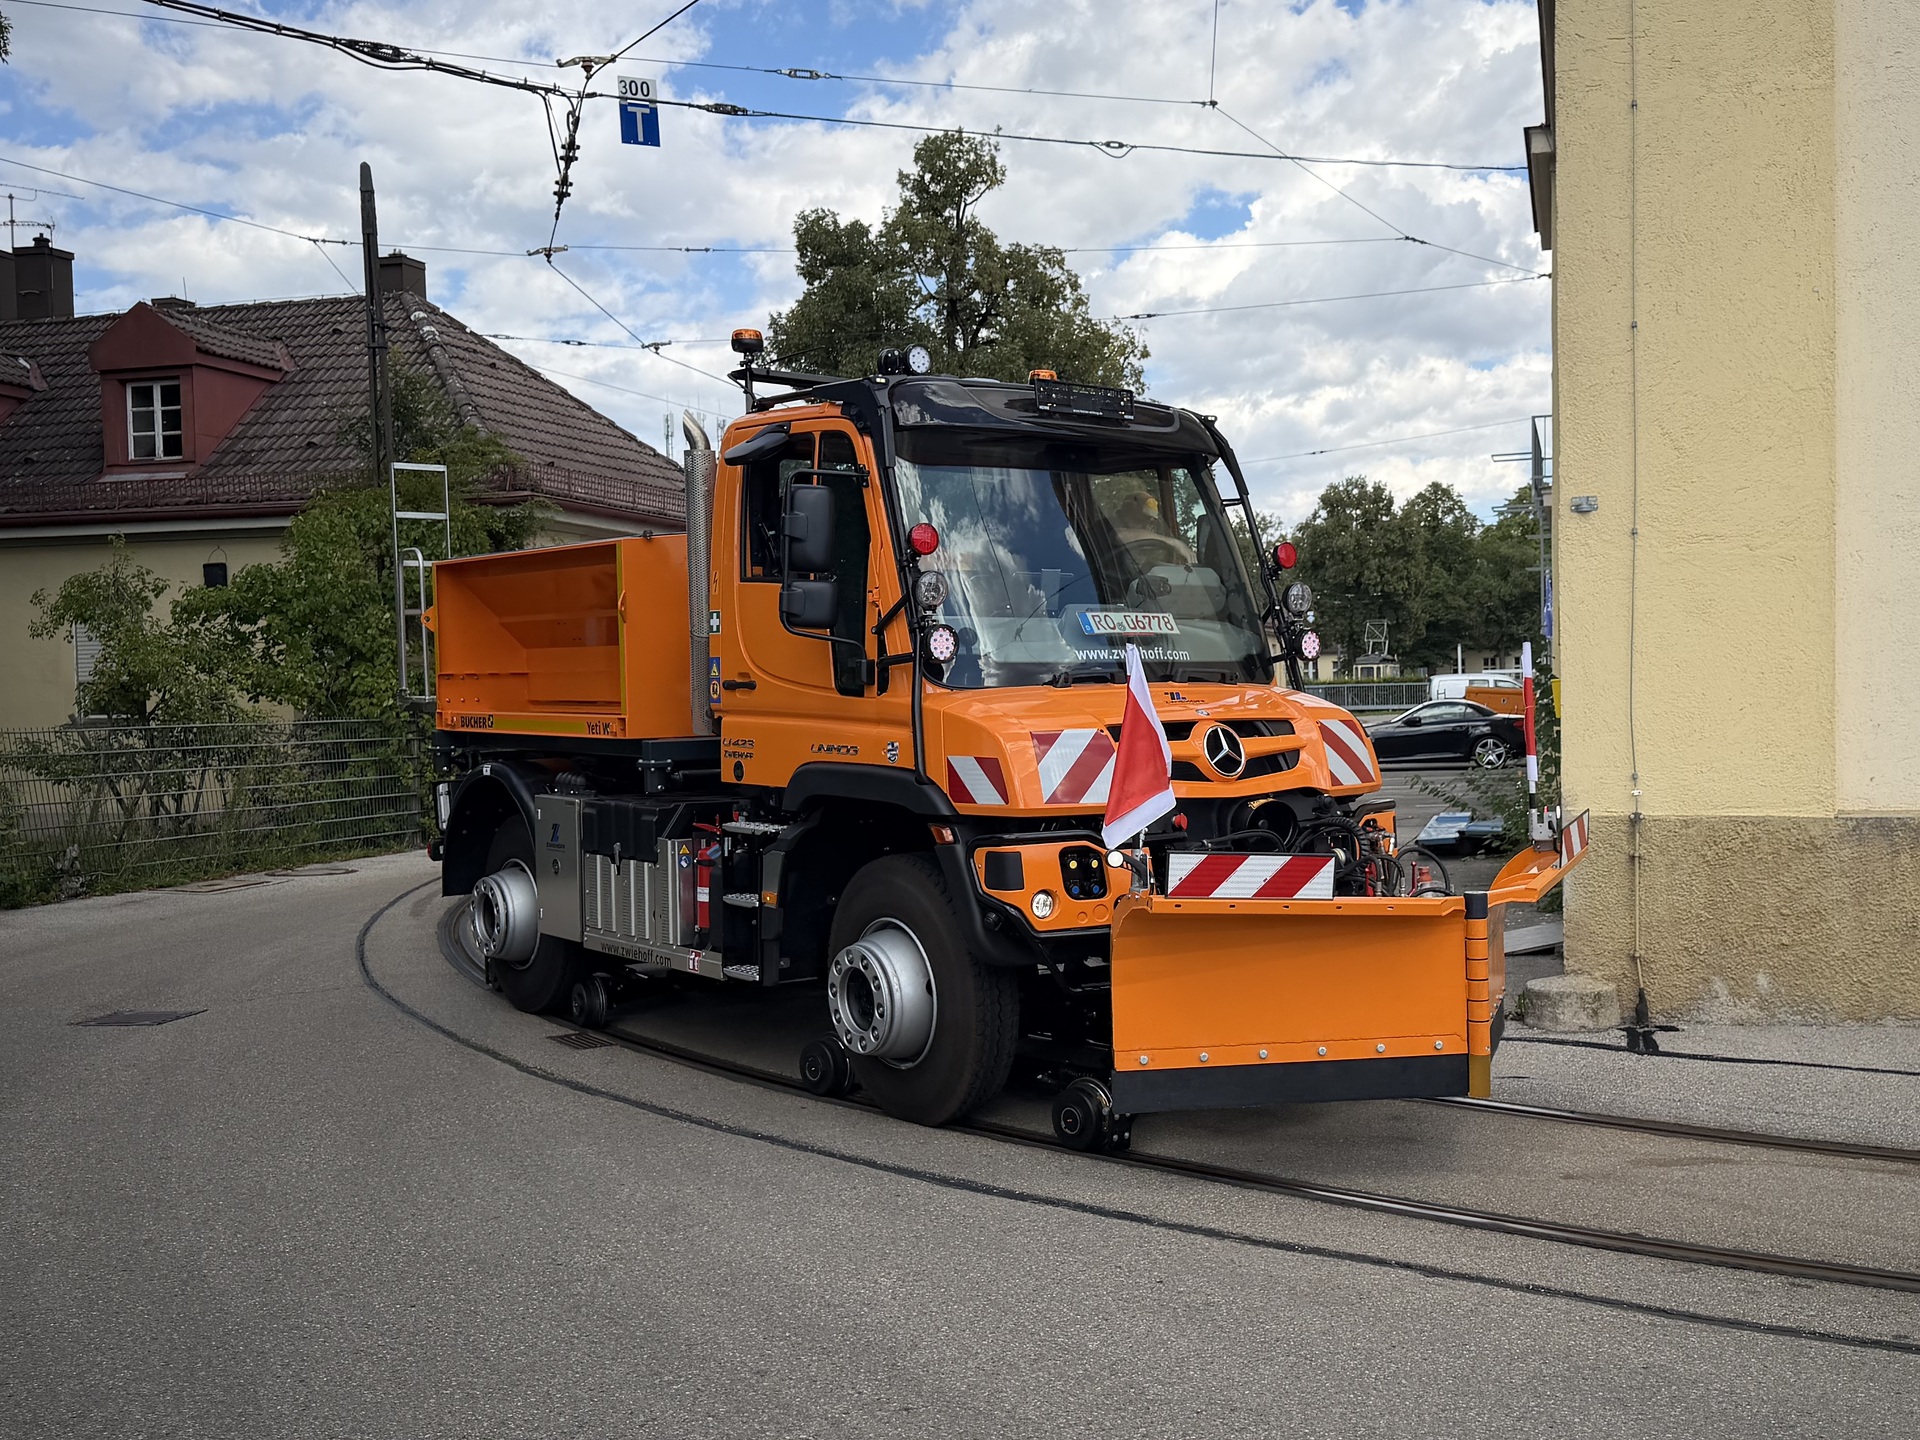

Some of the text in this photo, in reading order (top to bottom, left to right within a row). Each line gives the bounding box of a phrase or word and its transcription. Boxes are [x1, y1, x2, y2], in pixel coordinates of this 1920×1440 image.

[619, 79, 650, 97] 300
[627, 106, 650, 142] T
[1091, 614, 1117, 631] RO
[1123, 614, 1174, 632] 06778
[1075, 646, 1190, 661] www.zwhoff.com
[460, 715, 487, 729] BUCHER
[586, 720, 601, 735] Yeti
[810, 743, 860, 756] UNIMOG
[600, 942, 673, 968] www.zwiehoff.com
